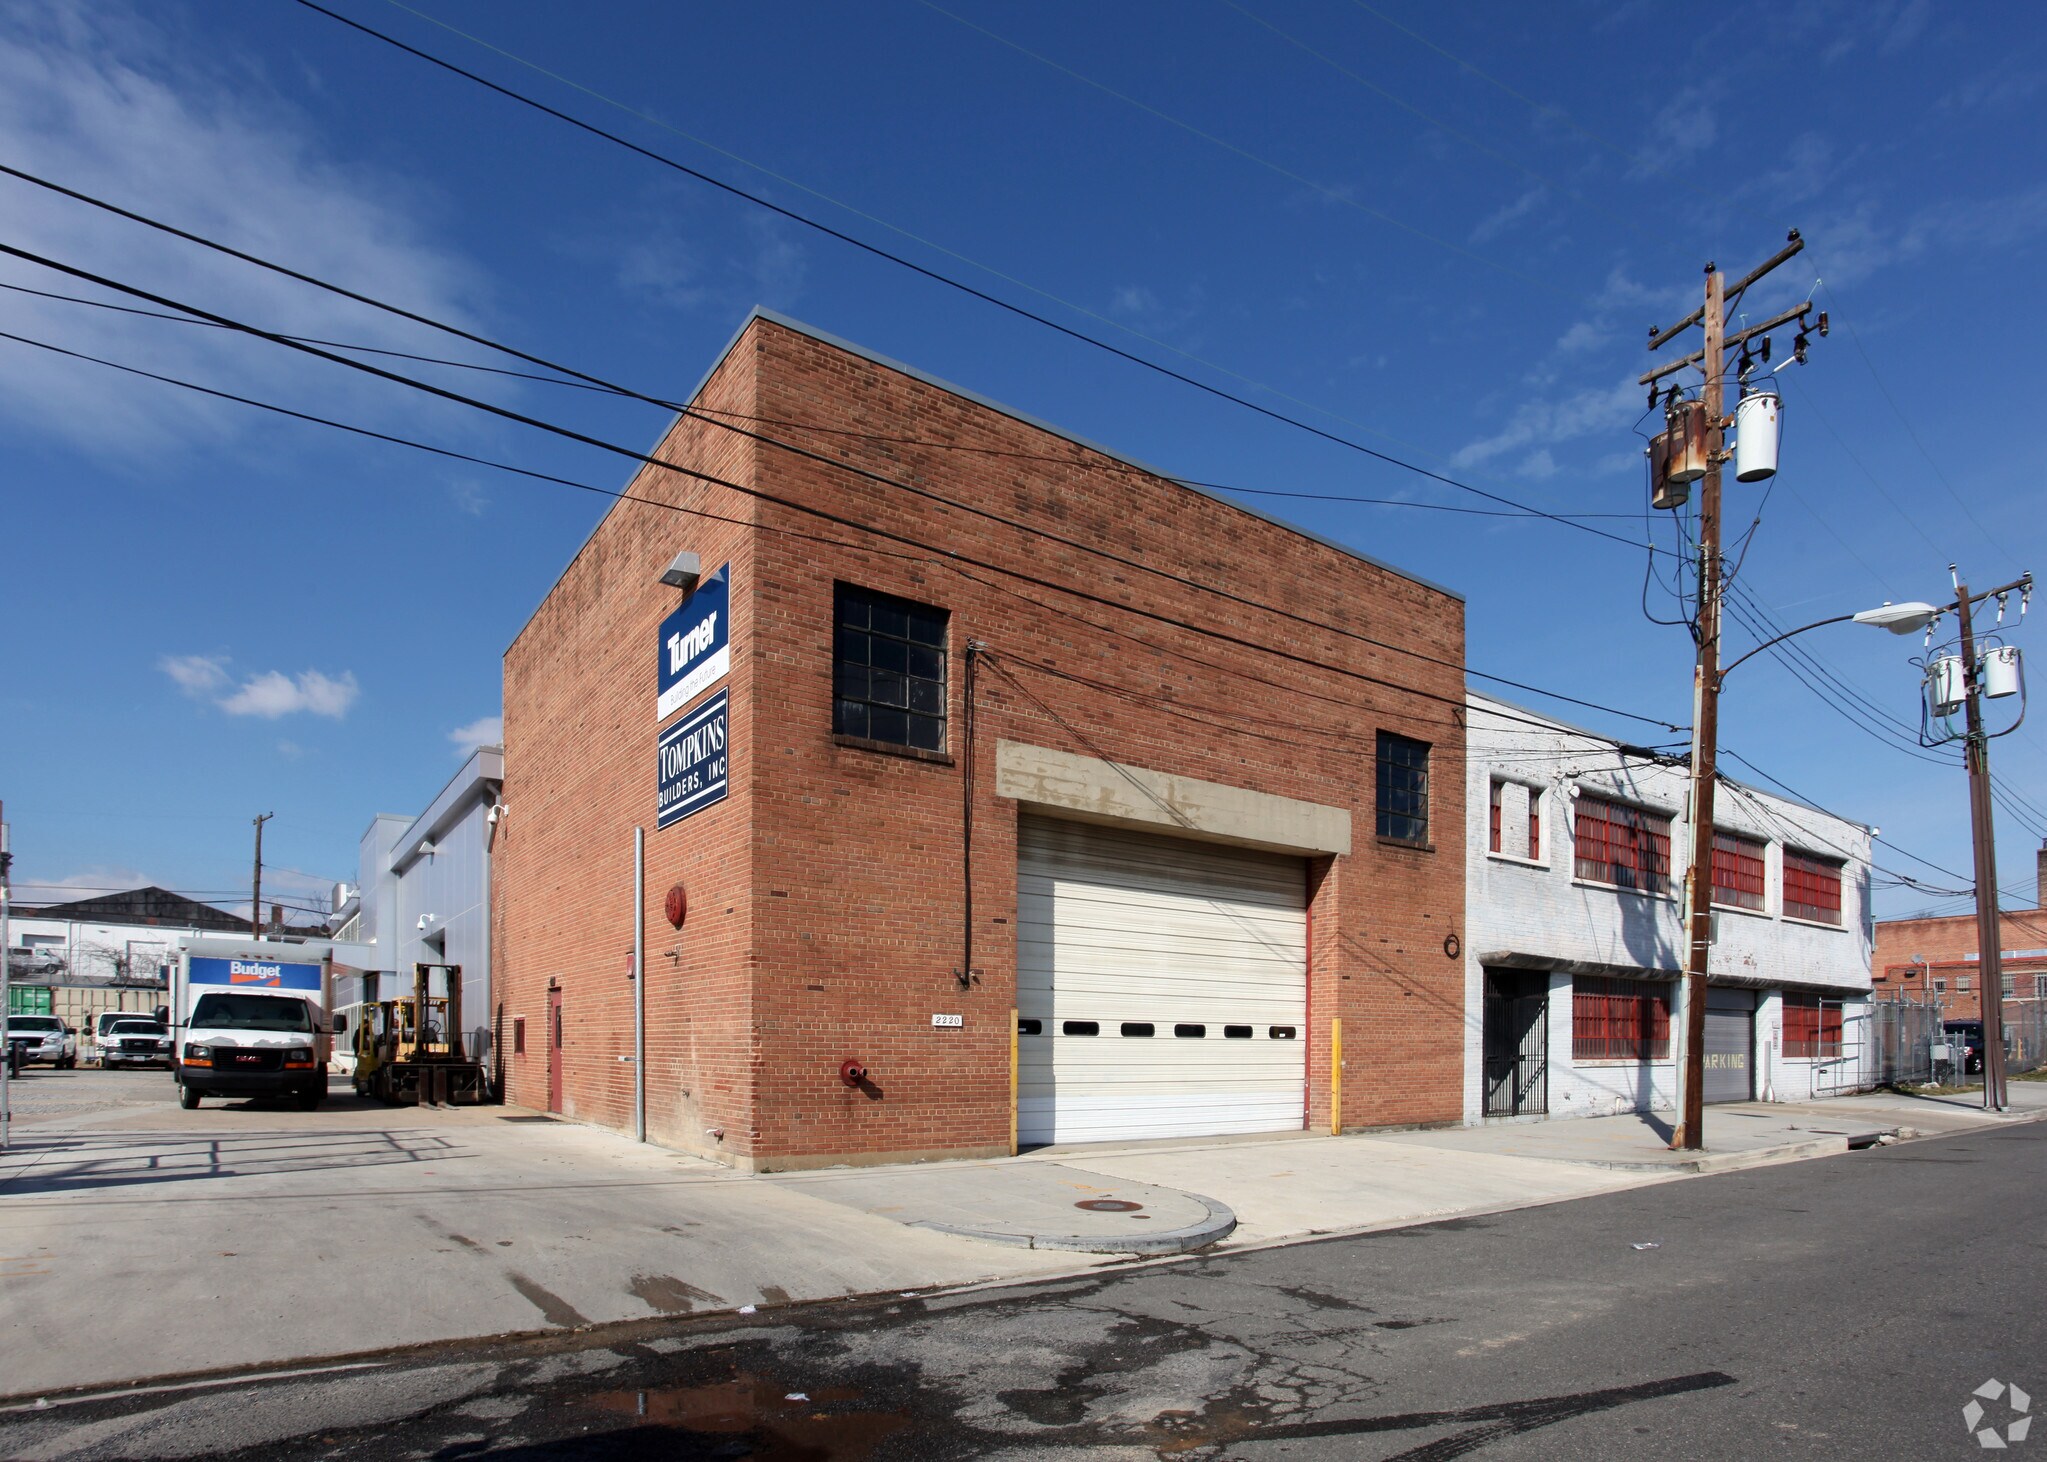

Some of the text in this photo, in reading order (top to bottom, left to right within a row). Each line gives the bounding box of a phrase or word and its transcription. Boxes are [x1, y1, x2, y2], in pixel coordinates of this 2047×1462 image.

[667, 610, 717, 676] Turner
[660, 714, 724, 784] TOMPKINS
[659, 756, 725, 808] BUILDERS, INC
[230, 961, 281, 979] Budget
[936, 1016, 960, 1025] 2220
